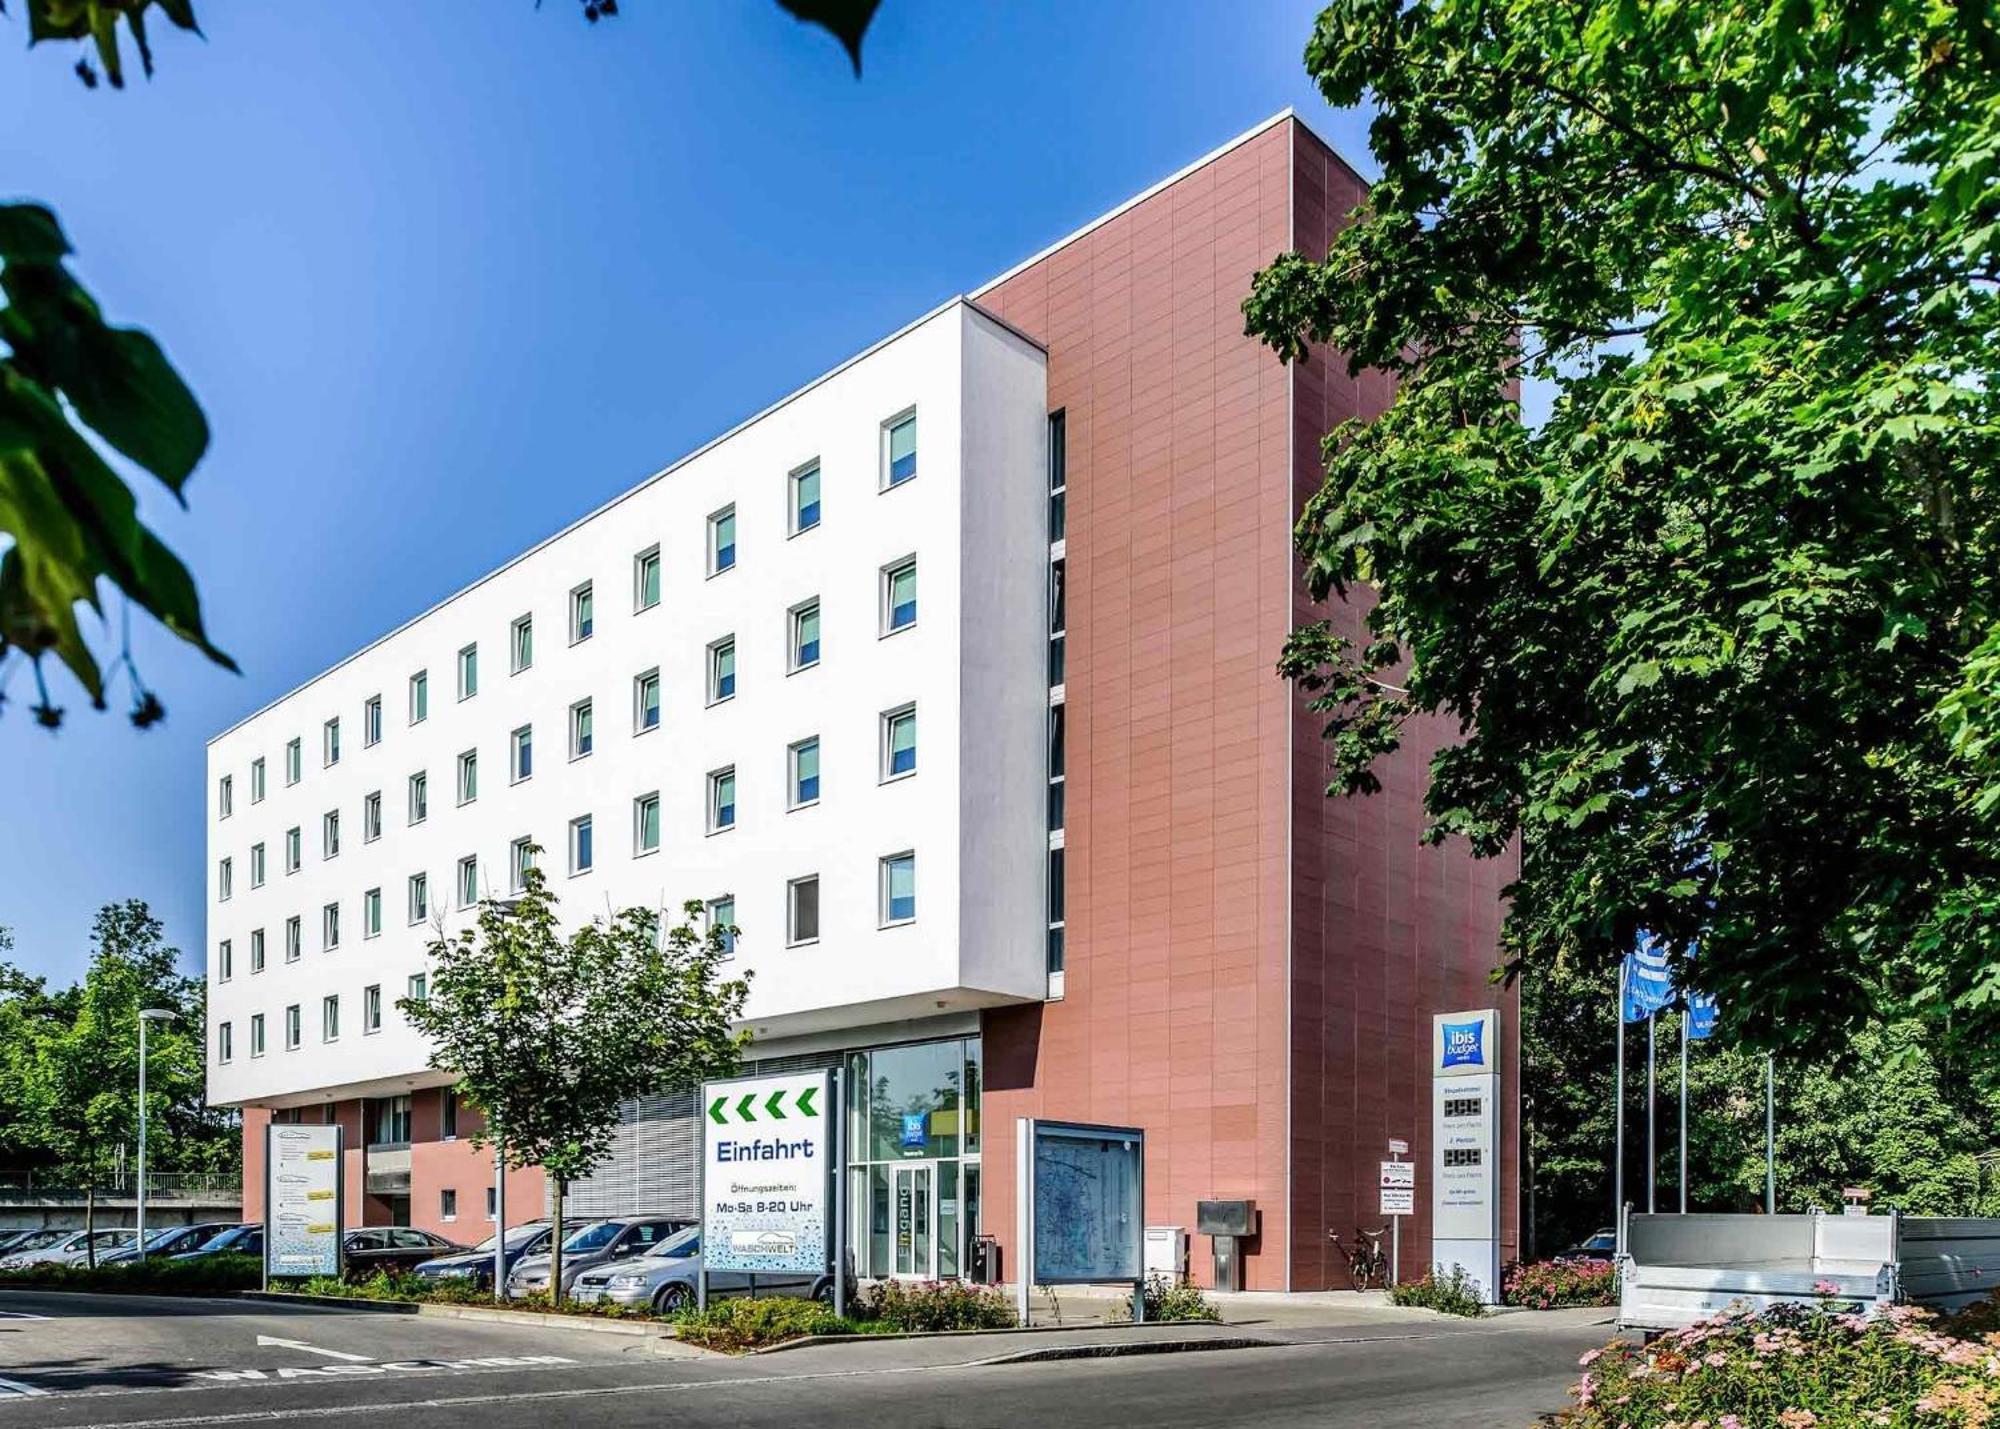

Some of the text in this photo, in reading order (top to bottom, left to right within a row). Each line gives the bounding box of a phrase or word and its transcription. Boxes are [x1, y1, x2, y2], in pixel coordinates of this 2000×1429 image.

[1451, 1029, 1475, 1045] ibis
[1447, 1043, 1479, 1055] budget
[716, 1138, 814, 1163] Einfahrt
[730, 1182, 797, 1194] Öffnungszeiten:
[756, 1201, 786, 1213] 8-20
[790, 1200, 813, 1213] Uhr
[898, 1185, 912, 1258] Eingang
